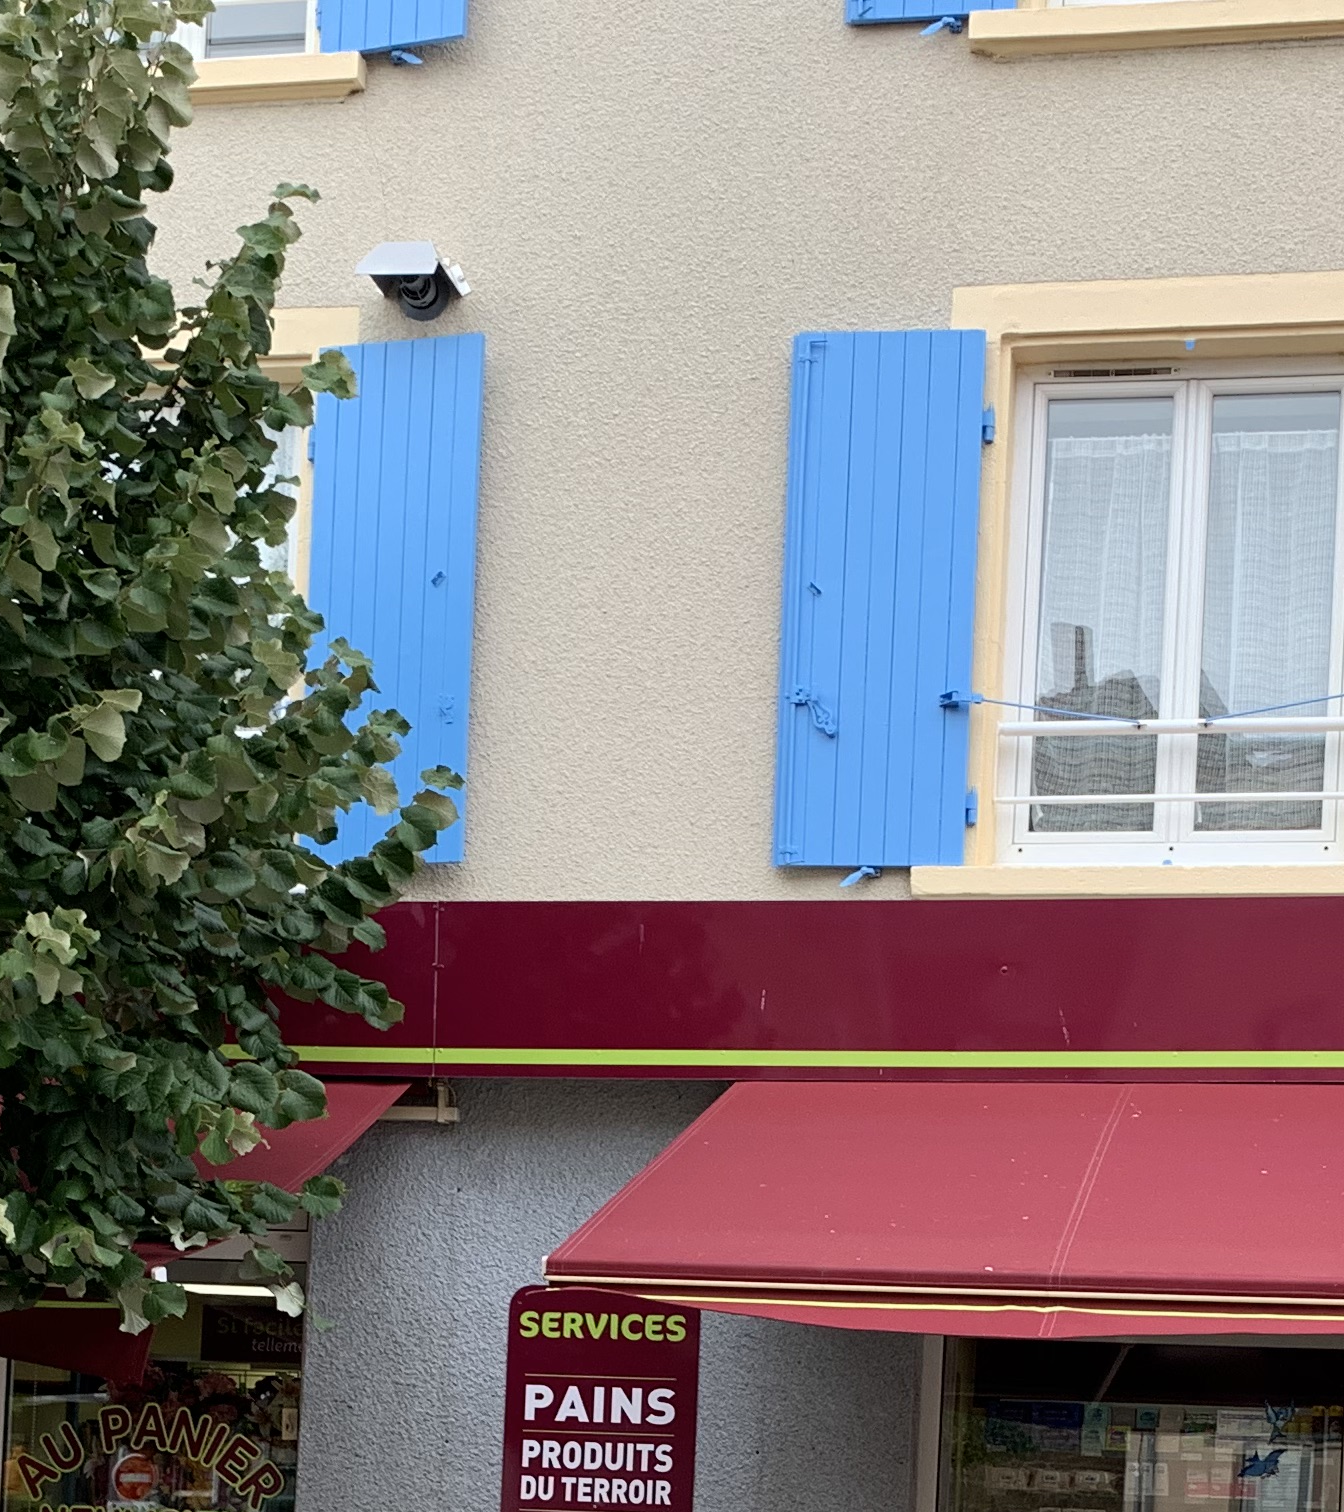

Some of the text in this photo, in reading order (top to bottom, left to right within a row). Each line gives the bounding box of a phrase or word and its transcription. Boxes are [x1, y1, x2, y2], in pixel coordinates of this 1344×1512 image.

[519, 1310, 687, 1342] SERVICES
[523, 1383, 676, 1425] PAINS
[16, 1402, 285, 1512] AU PANIER
[521, 1439, 673, 1473] PRODUITS
[520, 1475, 671, 1506] DU TERROIR
